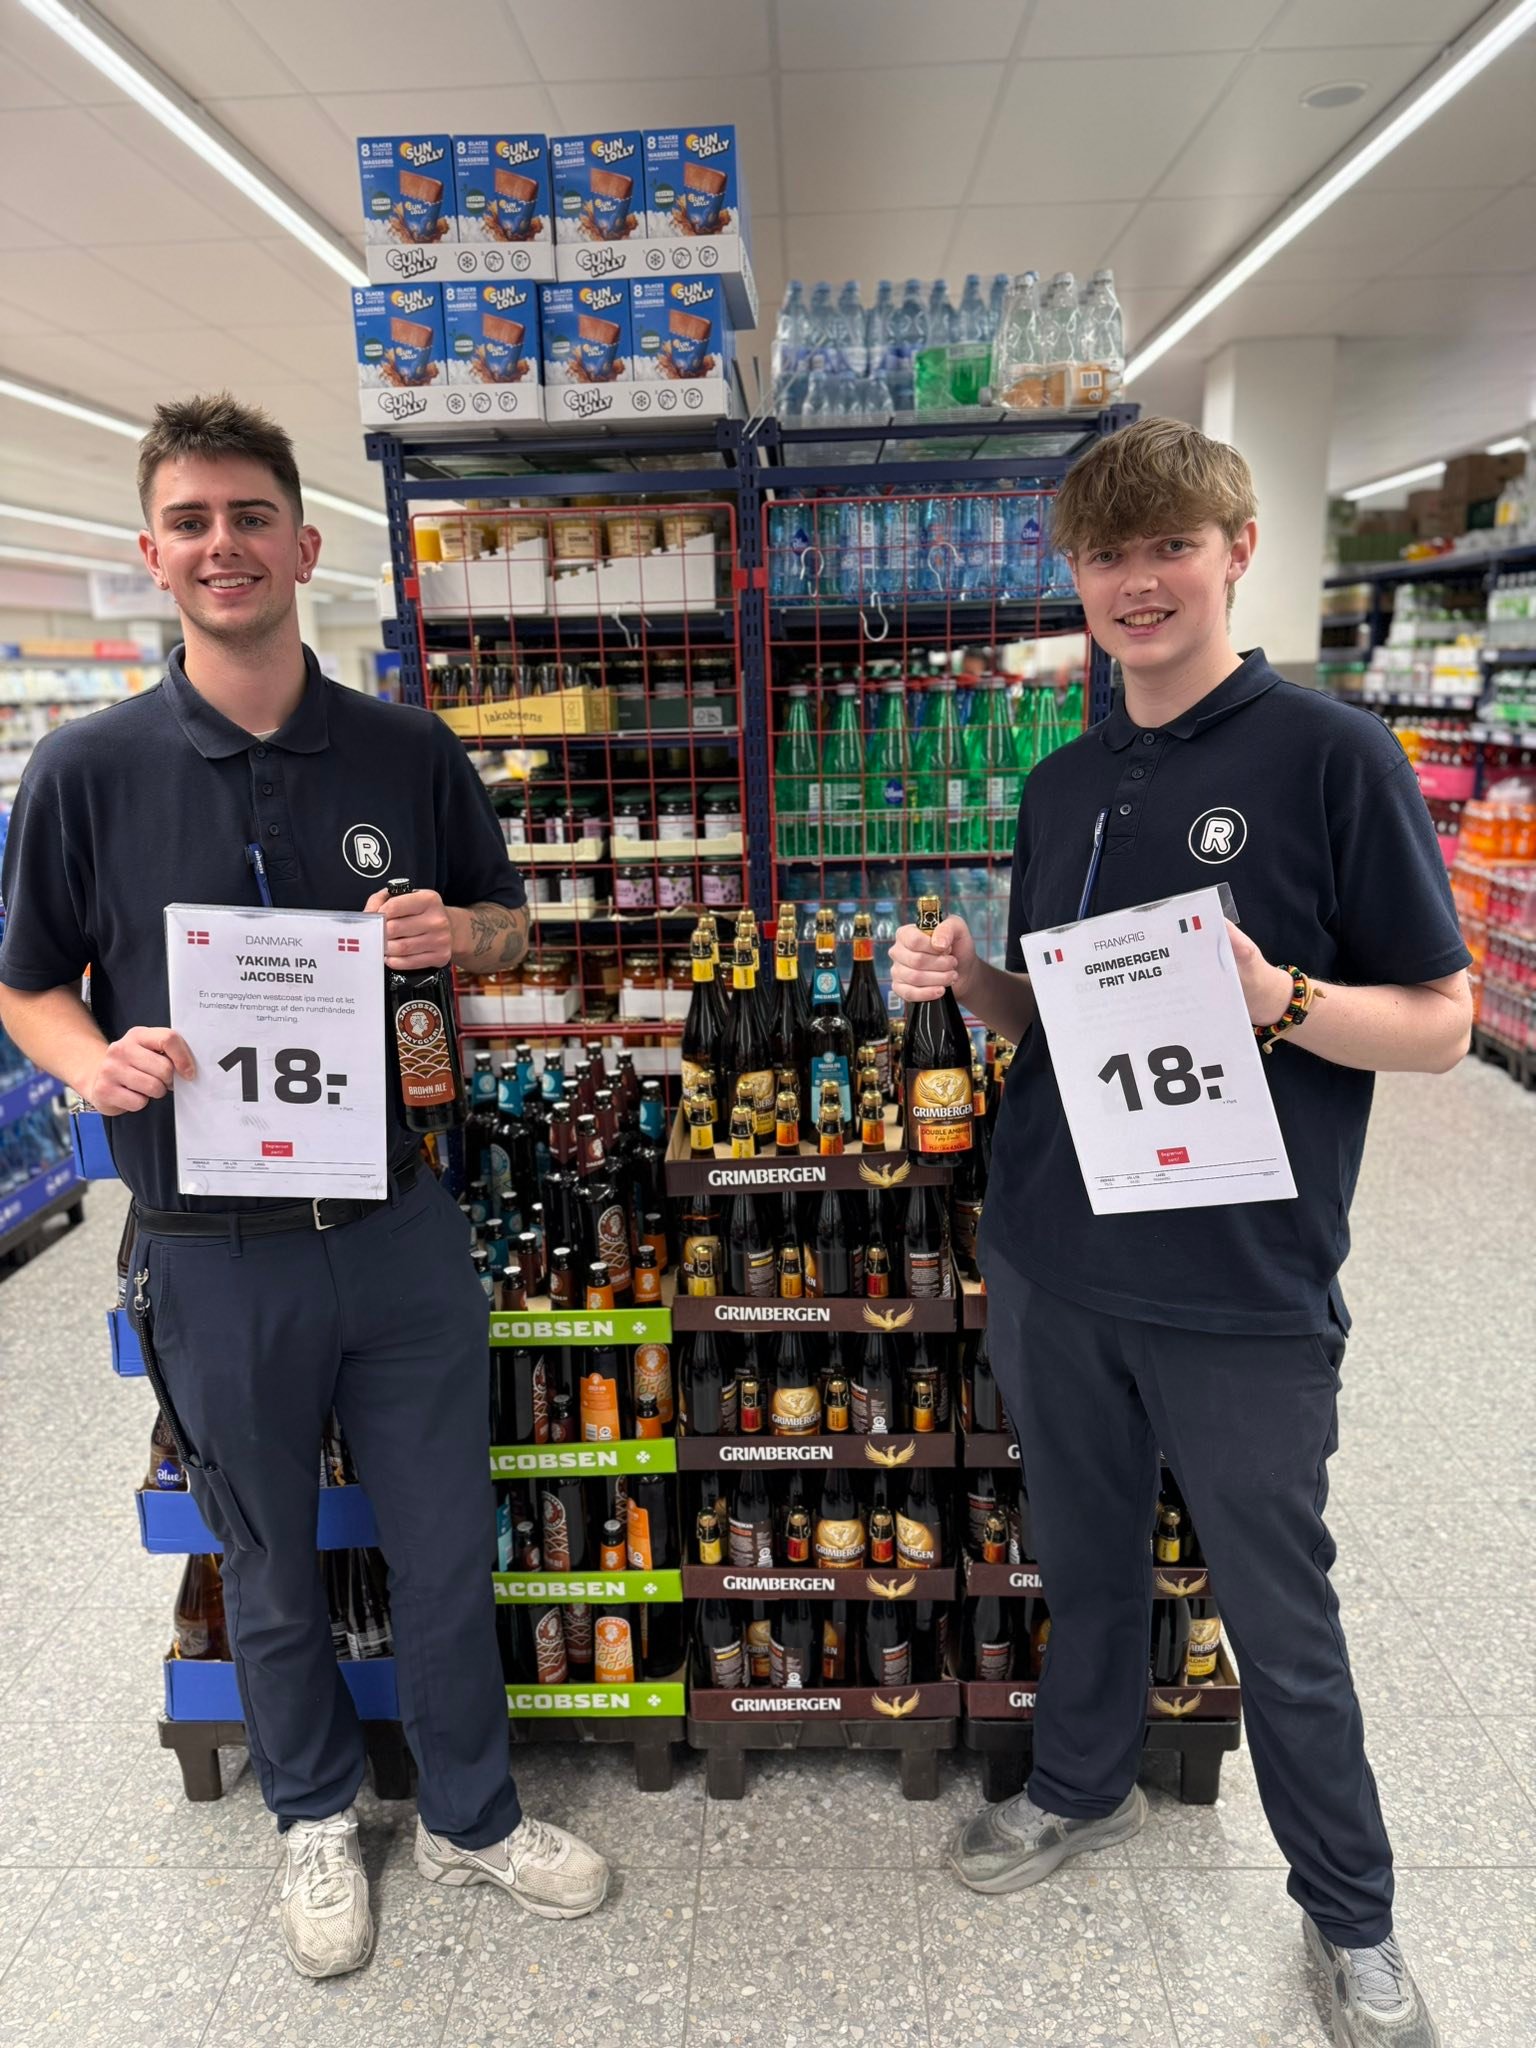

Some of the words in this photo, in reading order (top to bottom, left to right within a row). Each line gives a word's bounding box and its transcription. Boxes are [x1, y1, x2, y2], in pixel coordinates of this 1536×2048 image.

[361, 143, 370, 157] 8
[406, 141, 432, 160] SUN
[457, 142, 466, 156] 8
[502, 140, 528, 159] SUN
[553, 143, 562, 157] 8
[597, 138, 623, 157] SUN
[647, 136, 656, 149] 8
[691, 132, 718, 151] SUN
[698, 139, 729, 159] LOLLY
[413, 148, 444, 167] LOLLY
[509, 148, 540, 166] LOLLY
[604, 144, 634, 164] LOLLY
[393, 248, 423, 271] SUN
[402, 255, 437, 279] LOLLY
[582, 247, 613, 270] SUN
[591, 254, 626, 278] LOLLY
[354, 292, 363, 305] 8
[397, 289, 422, 308] SUN
[446, 288, 455, 300] 8
[489, 286, 515, 303] SUN
[543, 290, 552, 303] 8
[585, 286, 611, 304] SUN
[633, 284, 643, 297] 8
[677, 281, 703, 300] SUN
[683, 288, 714, 306] LOLLY
[404, 295, 434, 314] LOLLY
[496, 292, 527, 310] LOLLY
[592, 292, 623, 311] LOLLY
[385, 390, 414, 413] SUN
[570, 388, 600, 411] SUN
[578, 395, 612, 417] LOLLY
[394, 398, 427, 421] LOLLY
[1201, 817, 1234, 855] R
[354, 834, 382, 868] R
[245, 935, 303, 947] DANMARK
[1093, 931, 1145, 951] FRANKRIG
[236, 955, 291, 968] YAKIMA
[295, 958, 317, 969] IPA
[1084, 947, 1170, 975] GRIMBERGEN
[240, 971, 314, 984] JACOBSEN
[1099, 974, 1125, 989] FRIT
[1128, 966, 1162, 982] VALG
[199, 990, 209, 998] En
[262, 994, 303, 1002] westcoast
[303, 995, 316, 1003] ipa
[290, 1005, 304, 1013] den
[399, 1003, 439, 1021] JACOBSEN
[402, 1028, 440, 1045] BRYGGERI
[408, 1085, 434, 1096] BROWN
[434, 1082, 447, 1093] ALE
[912, 1103, 973, 1118] GRIMBERGEN
[708, 1166, 827, 1186] GRIMBERGEN
[714, 1304, 831, 1322] GRIMBERGEN
[772, 1411, 821, 1426] GRIMBERGEN
[489, 1451, 618, 1471] ACOBSEN
[719, 1446, 834, 1461] GRIMBERGEN
[157, 1468, 184, 1481] Blue
[815, 1543, 865, 1557] GRIMBERGEN
[493, 1582, 625, 1597] ACOBSEN
[723, 1575, 836, 1591] GRIMBERGEN
[508, 1693, 630, 1710] ACOBSEN
[731, 1697, 841, 1713] GRIMBERGEN
